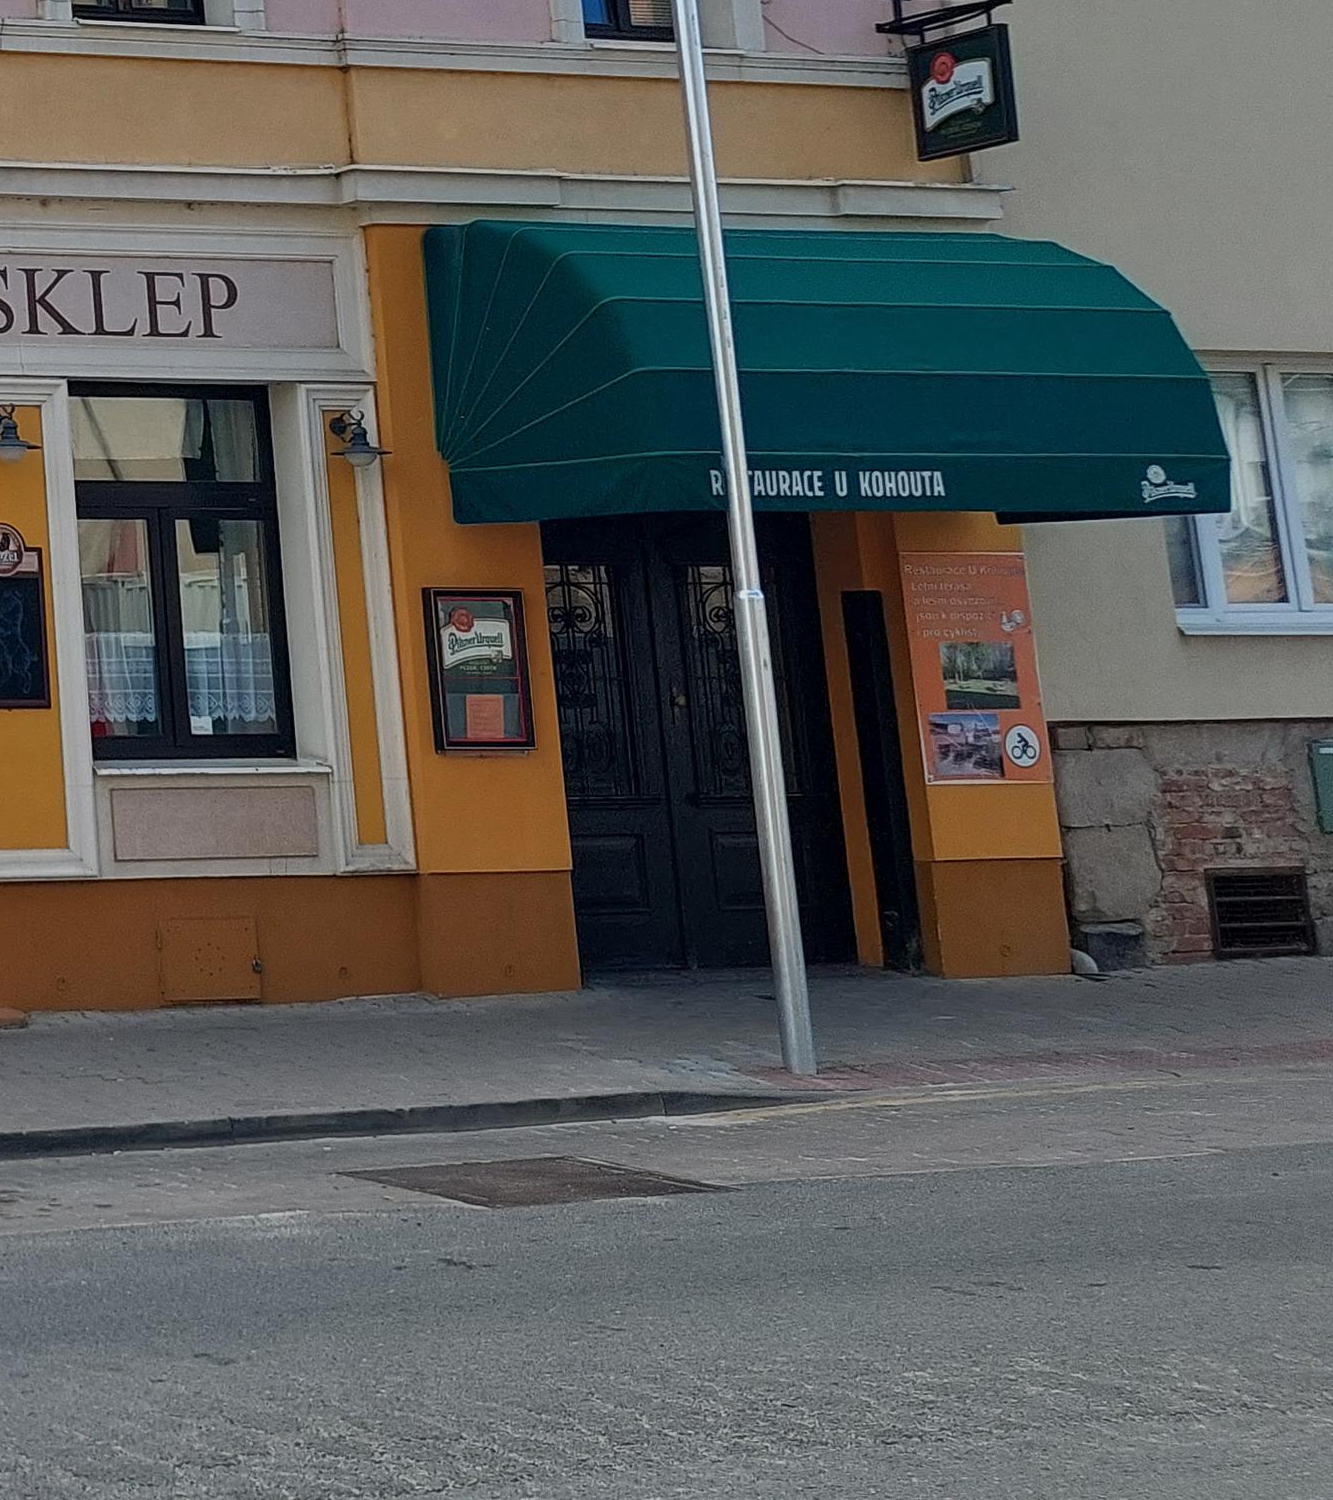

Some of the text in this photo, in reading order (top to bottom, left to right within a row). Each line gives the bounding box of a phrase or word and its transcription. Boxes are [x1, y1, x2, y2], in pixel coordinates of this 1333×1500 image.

[835, 470, 848, 497] U
[859, 470, 946, 498] KOHOUTA
[448, 631, 504, 656] Pilsner Urquell
